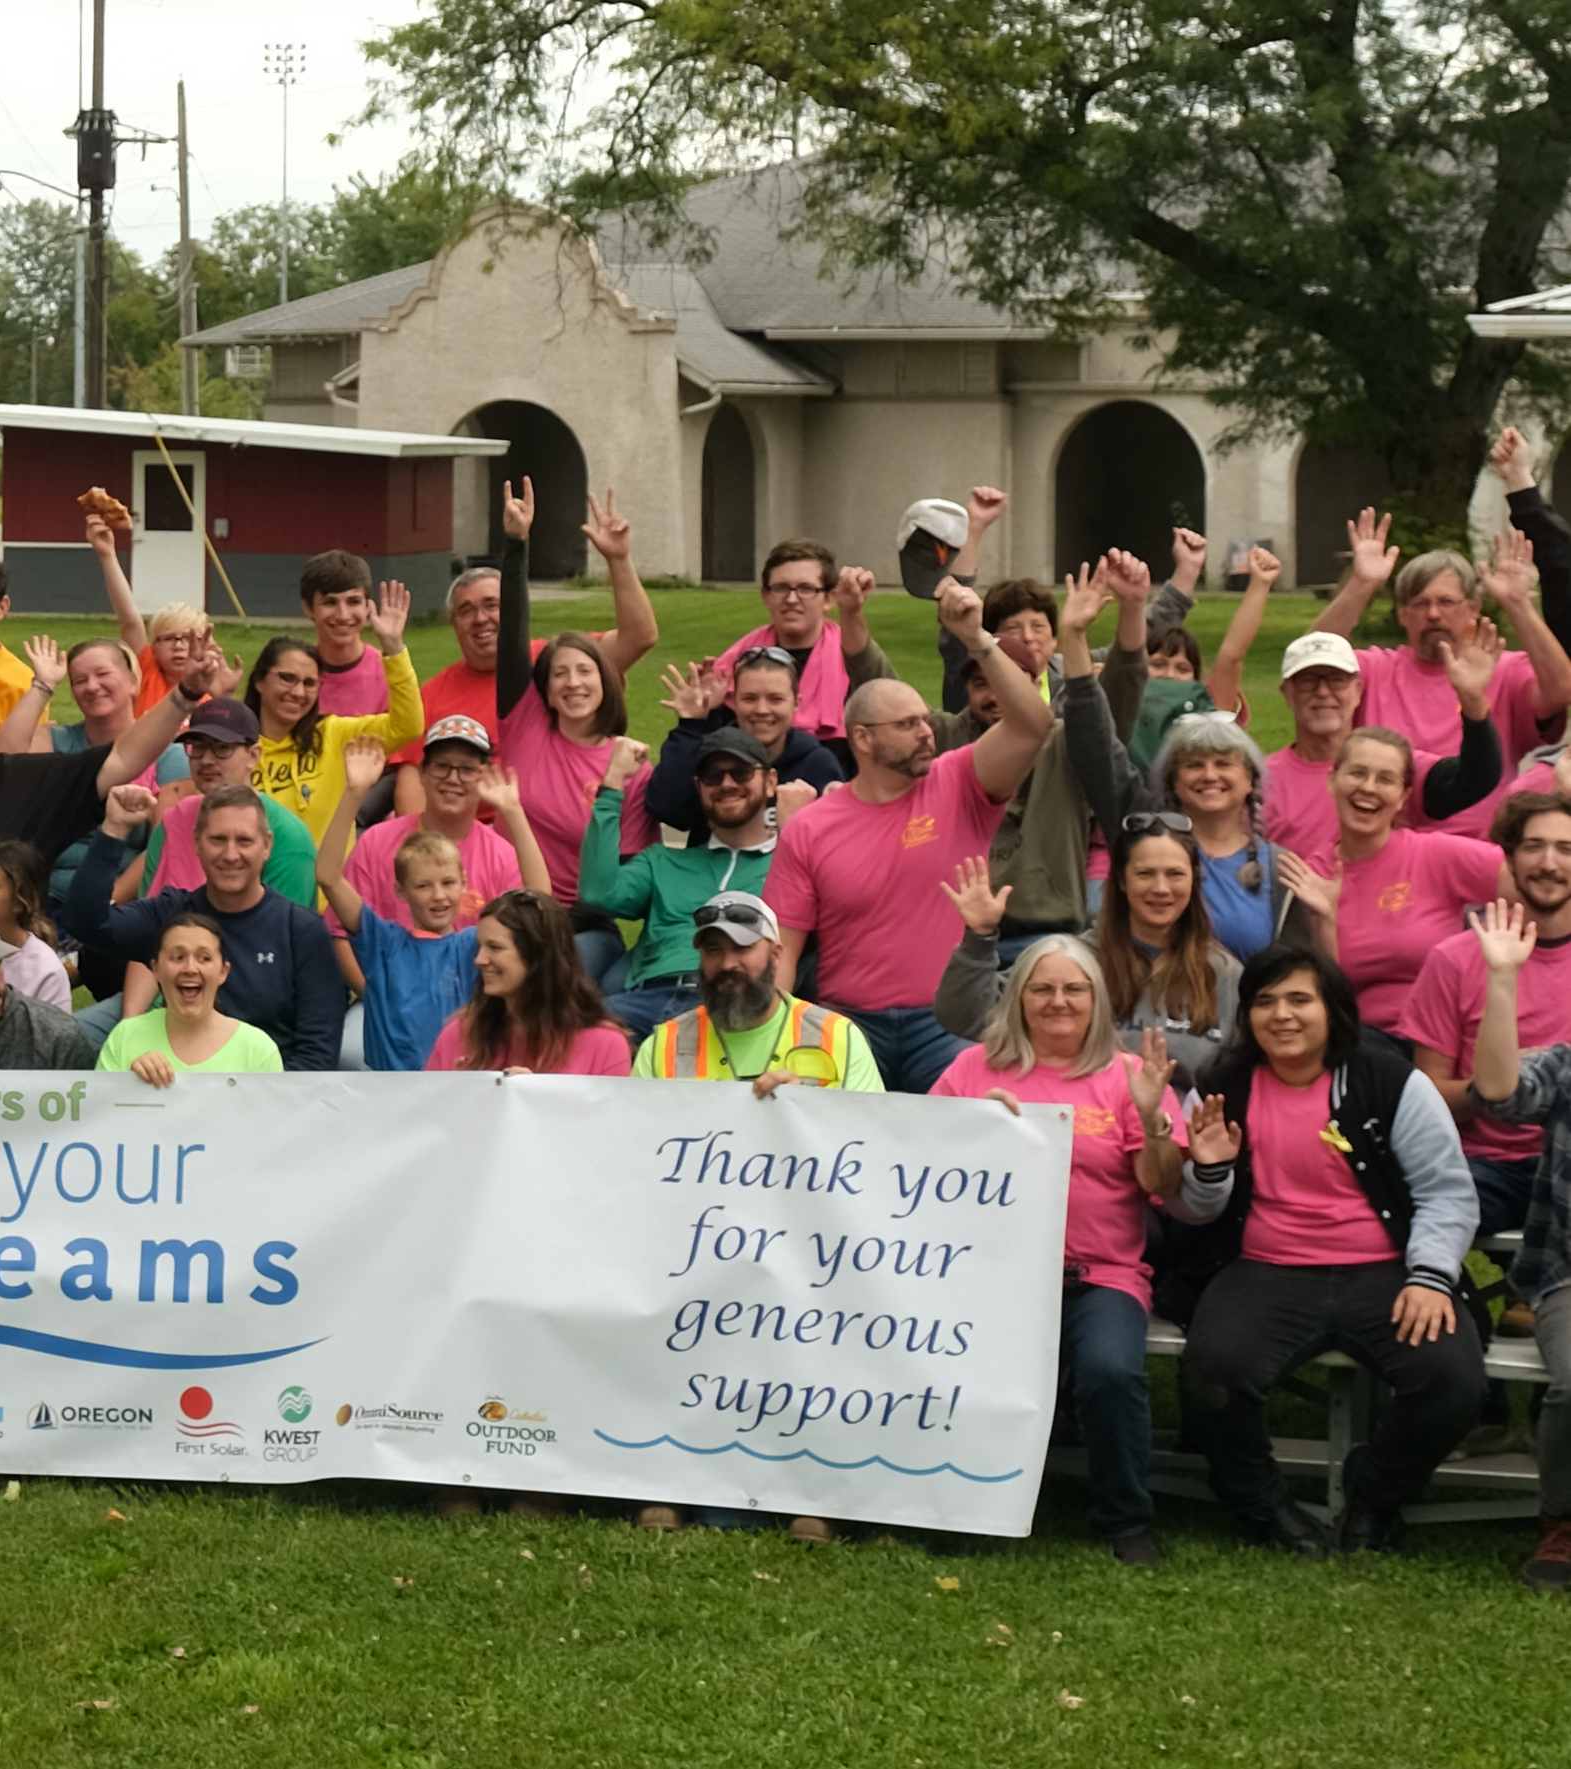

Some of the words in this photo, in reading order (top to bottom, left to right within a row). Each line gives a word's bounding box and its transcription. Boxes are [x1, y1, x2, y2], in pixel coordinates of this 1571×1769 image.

[38, 1081, 87, 1122] of
[0, 1140, 206, 1223] your
[656, 1130, 865, 1196] Thank
[889, 1163, 1017, 1219] you
[668, 1205, 787, 1278] for
[808, 1229, 974, 1288] your
[665, 1299, 974, 1356] generous
[61, 1406, 153, 1424] OREGON
[680, 1371, 963, 1437] support!
[264, 1430, 322, 1445] KWEST
[466, 1421, 558, 1442] OUTDOOR
[176, 1442, 205, 1454] First
[263, 1446, 319, 1462] GROUP
[486, 1440, 536, 1456] FUND
